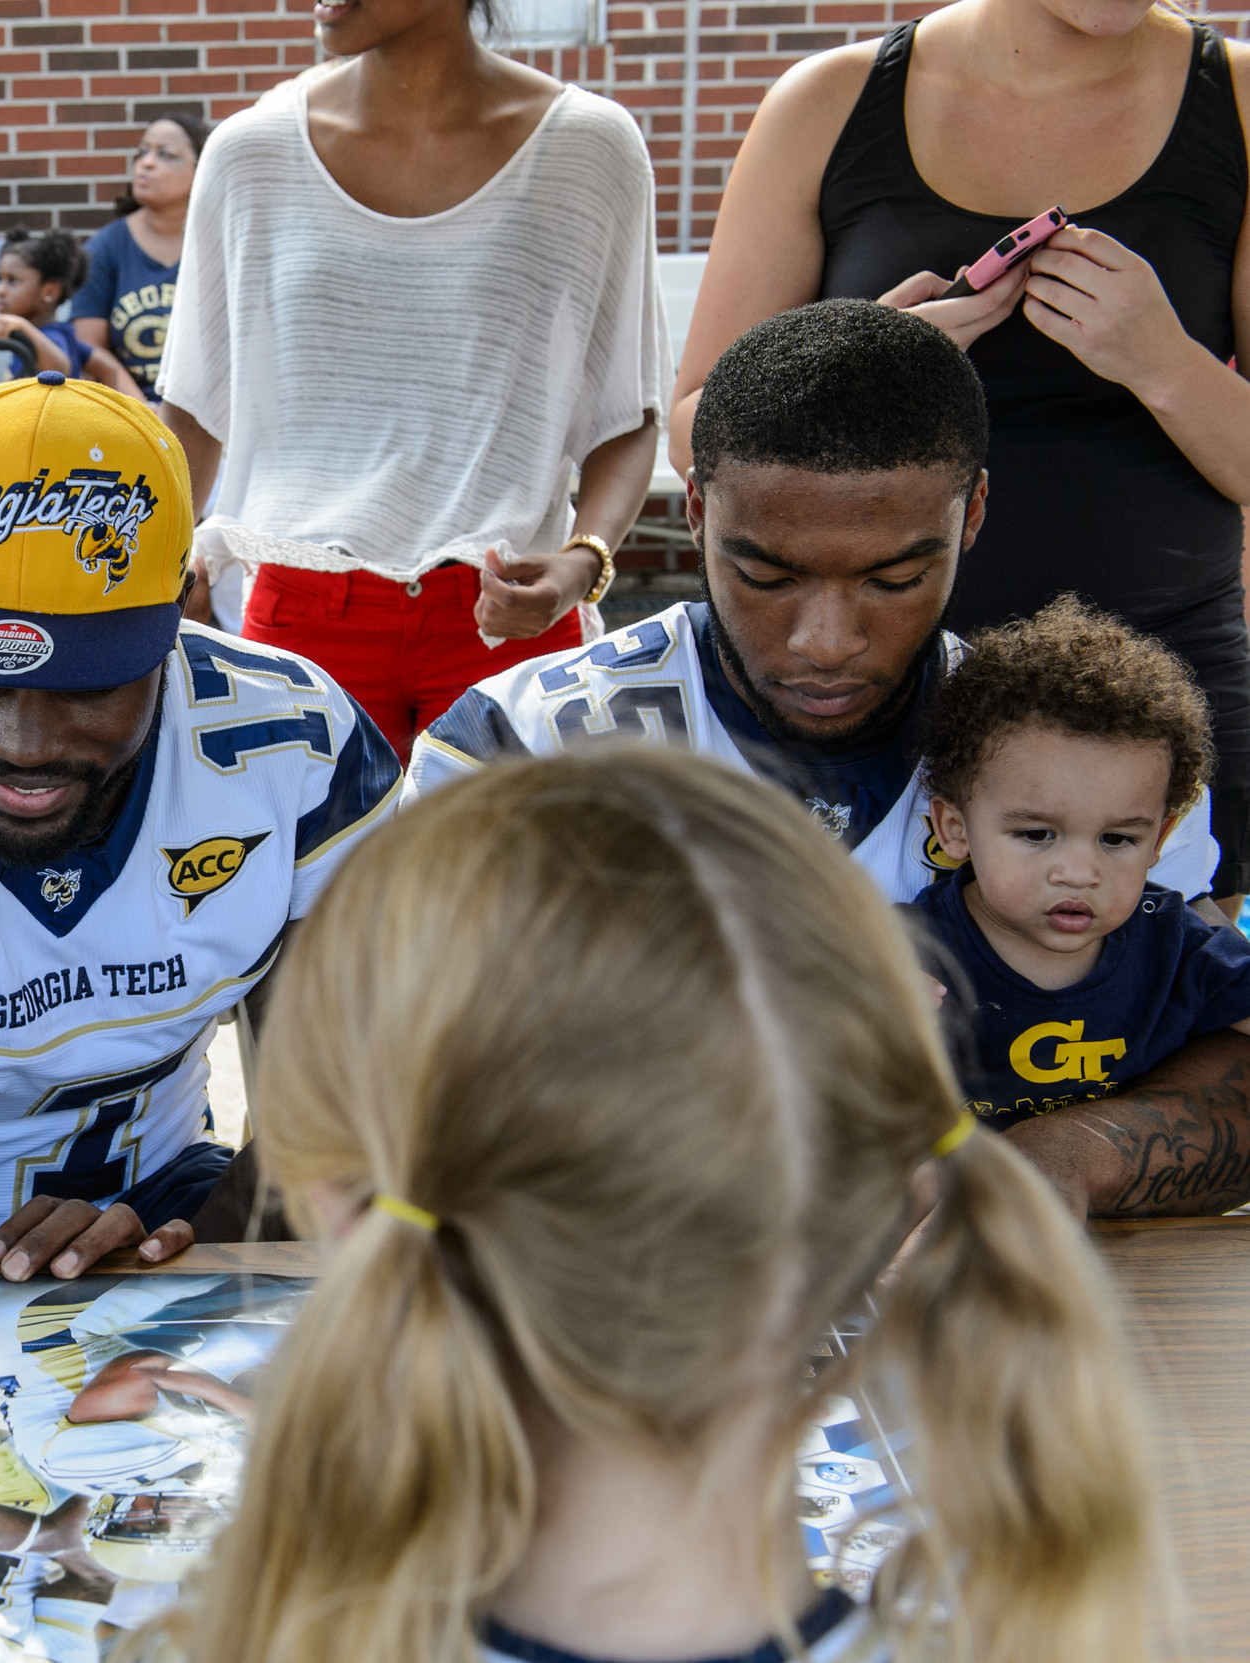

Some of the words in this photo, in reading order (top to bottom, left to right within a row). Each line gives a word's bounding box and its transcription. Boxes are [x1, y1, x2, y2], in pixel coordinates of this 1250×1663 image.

[62, 468, 158, 535] Tech
[177, 627, 338, 776] 17
[176, 849, 236, 885] ACC
[102, 953, 187, 997] TECH
[1009, 1019, 1128, 1084] GT
